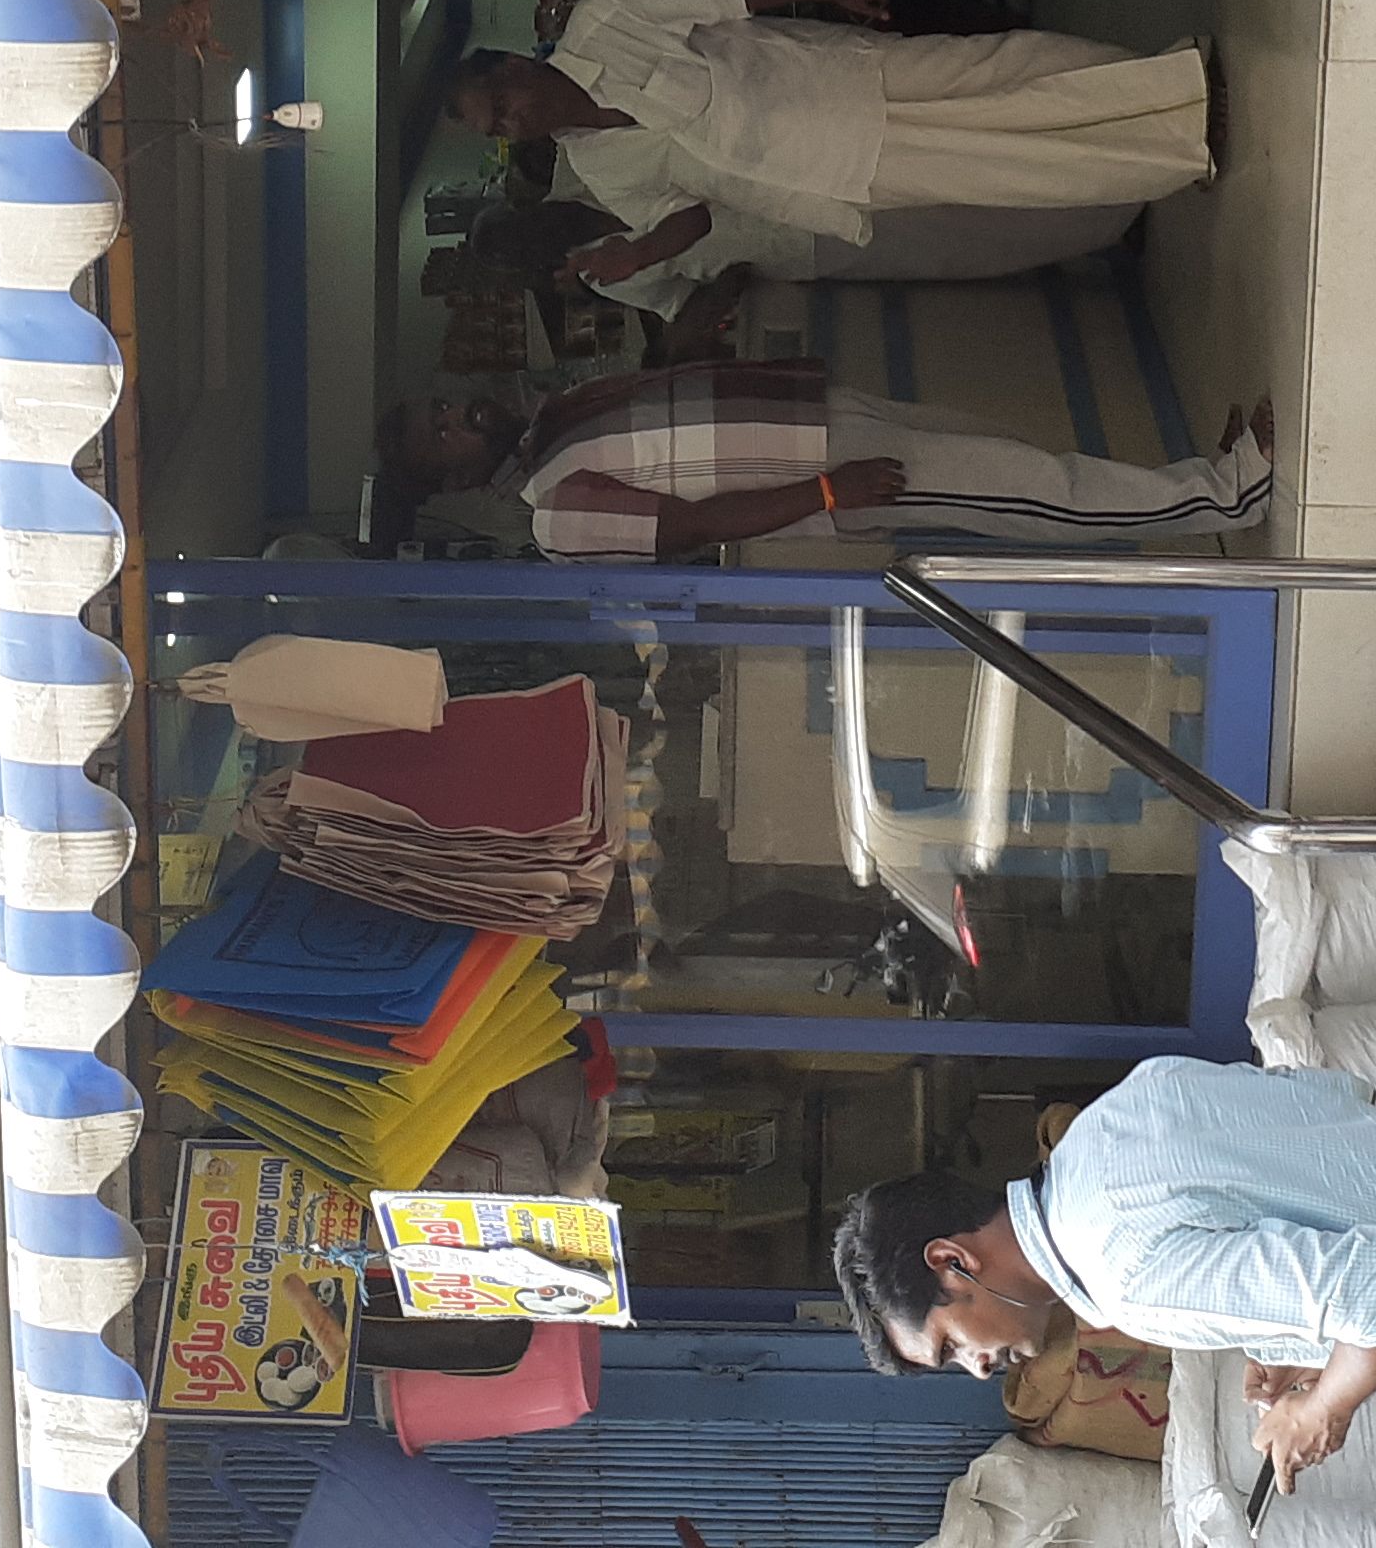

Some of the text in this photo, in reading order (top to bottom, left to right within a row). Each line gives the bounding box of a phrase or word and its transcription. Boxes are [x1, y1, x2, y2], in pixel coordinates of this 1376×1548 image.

[172, 1200, 246, 1402] புதிய சுவை
[232, 1158, 289, 1348] இட்லி & தோசை மாவு
